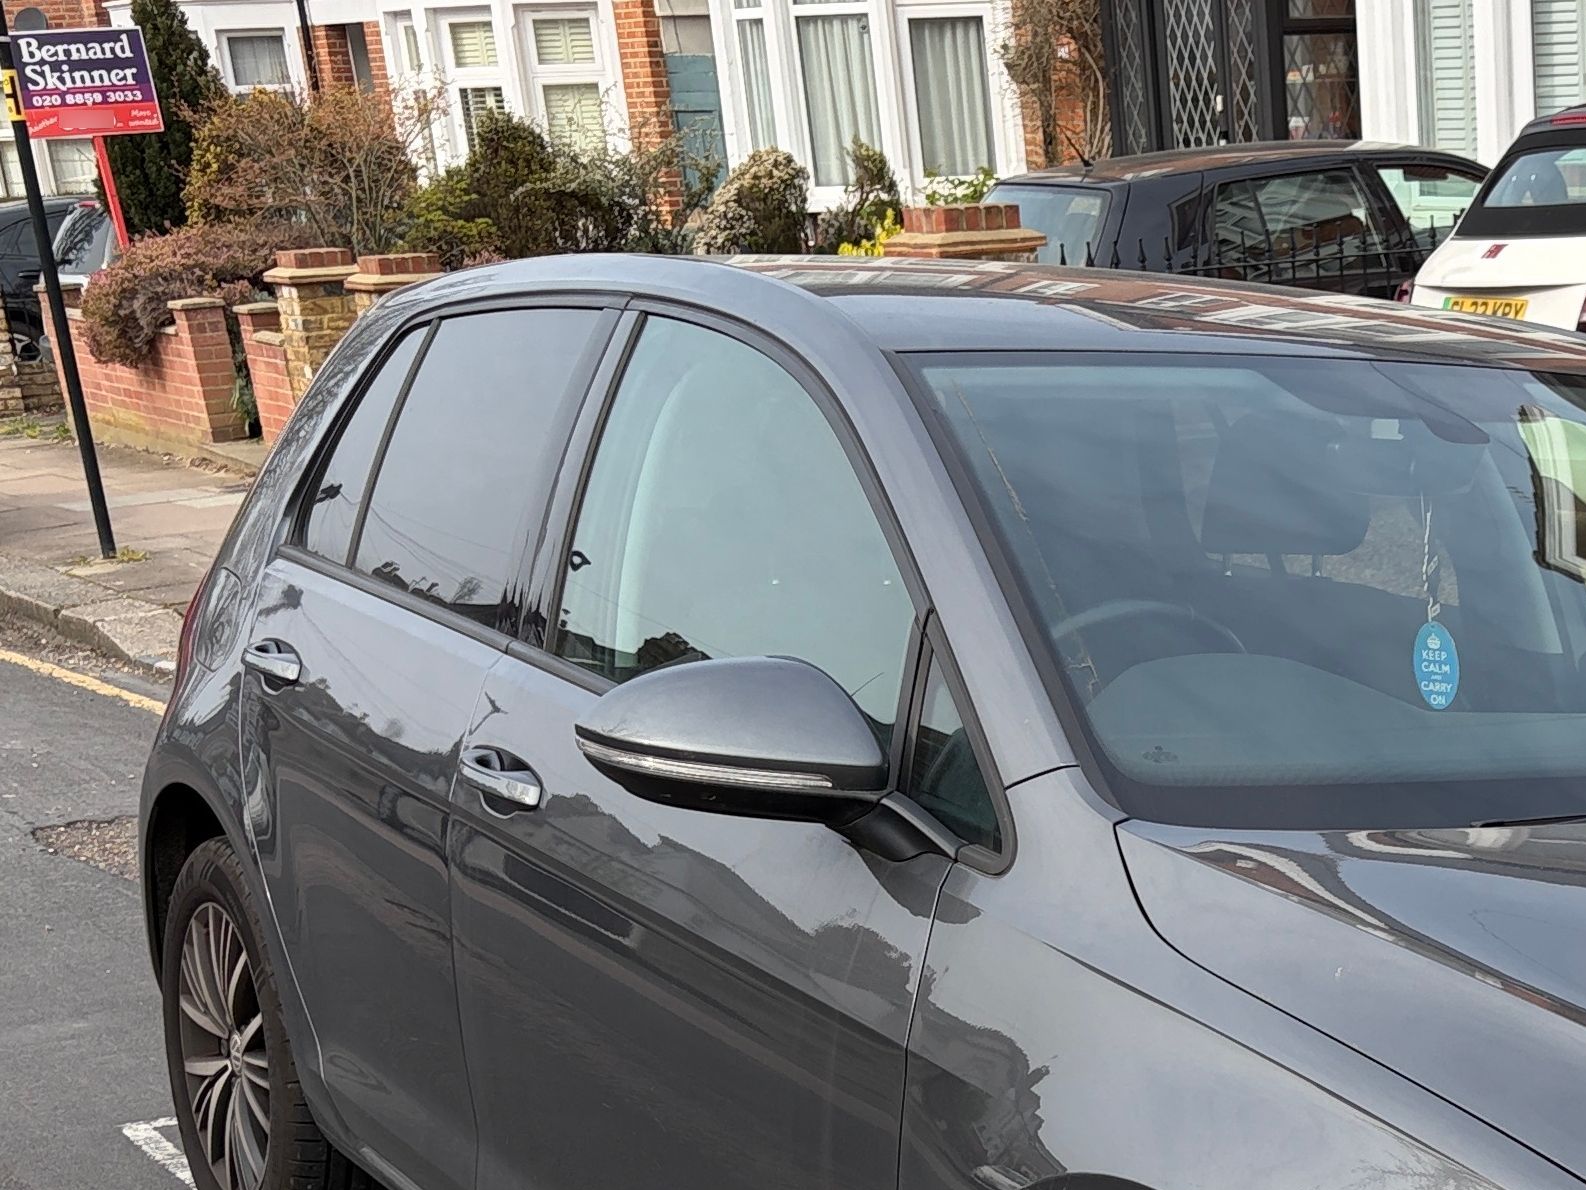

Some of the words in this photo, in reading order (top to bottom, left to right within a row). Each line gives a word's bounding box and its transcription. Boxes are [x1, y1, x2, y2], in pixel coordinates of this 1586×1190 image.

[17, 33, 134, 63] Bernard
[24, 64, 138, 91] Skinner
[32, 95, 62, 107] 020
[65, 92, 103, 105] 8859
[106, 90, 143, 102] 3033
[1421, 649, 1447, 661] KEEP
[1421, 662, 1451, 674] CALM
[1420, 681, 1453, 693] CARRY
[1430, 695, 1446, 705] ON
